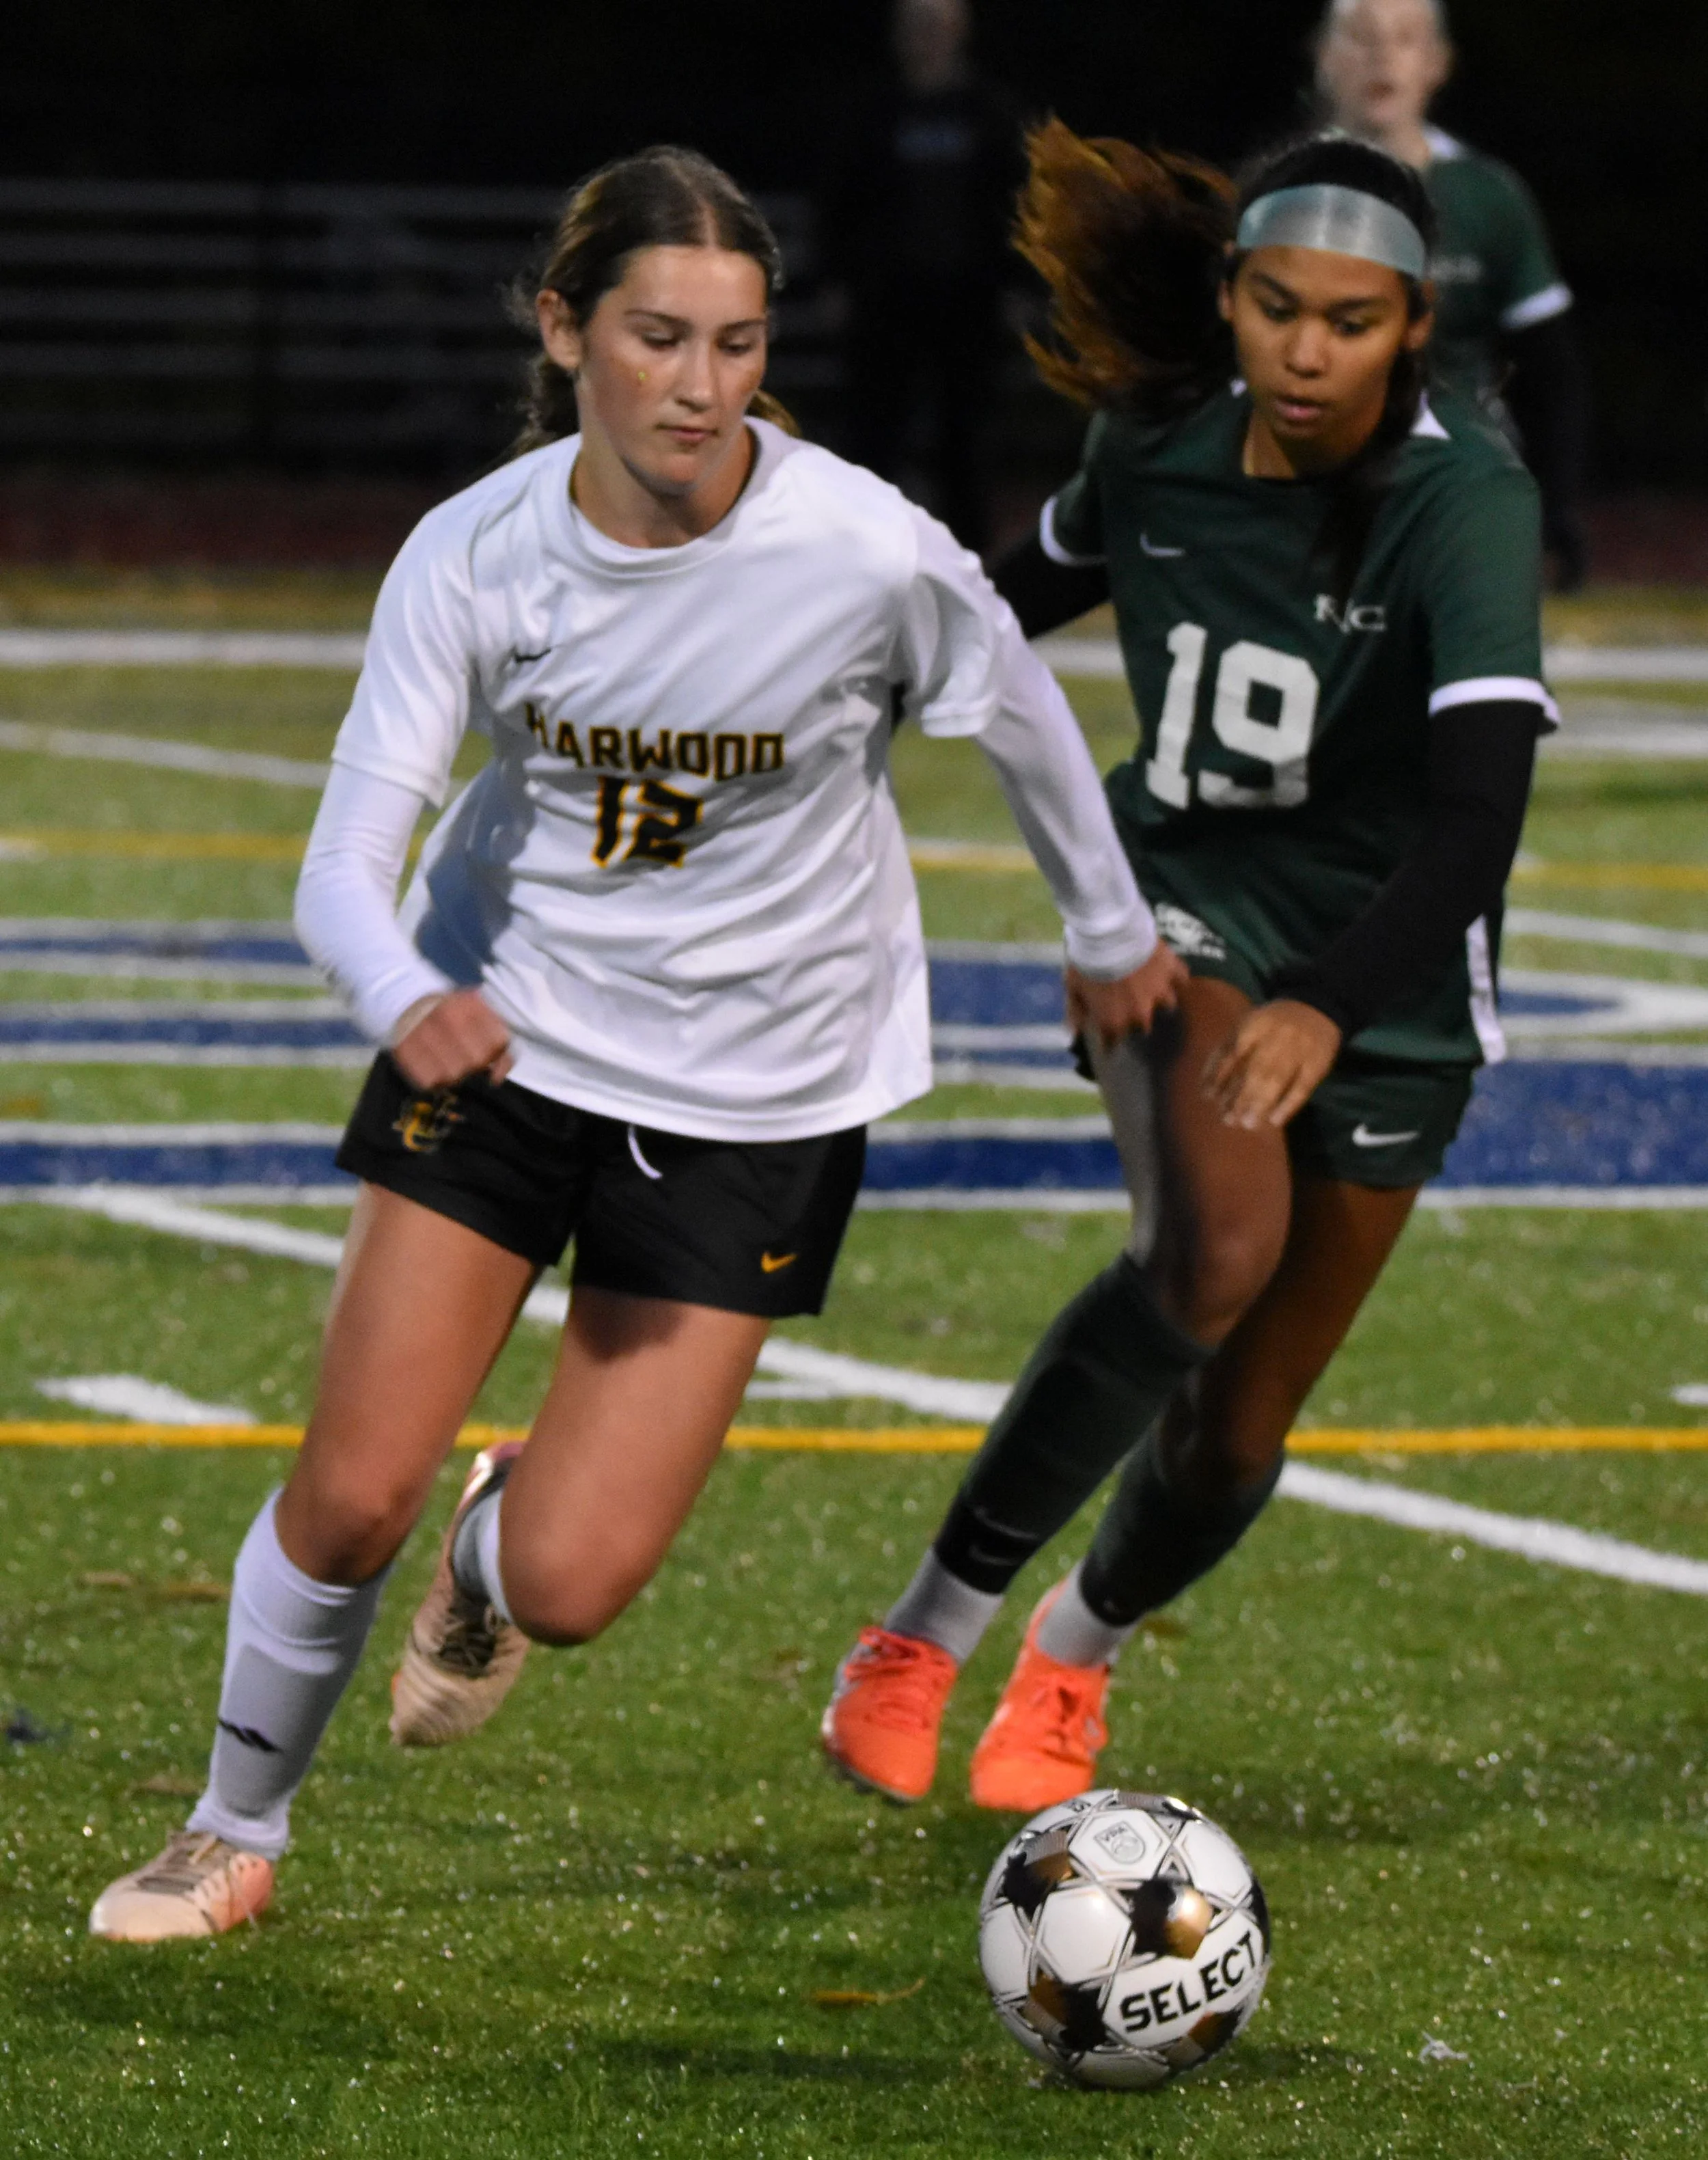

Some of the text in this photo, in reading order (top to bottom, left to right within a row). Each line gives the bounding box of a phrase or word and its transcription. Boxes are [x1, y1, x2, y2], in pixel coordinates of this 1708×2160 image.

[526, 700, 784, 783] HARWOOD
[1146, 621, 1319, 810] 19
[591, 775, 703, 869] 12
[1120, 1931, 1258, 2033] SELECT
